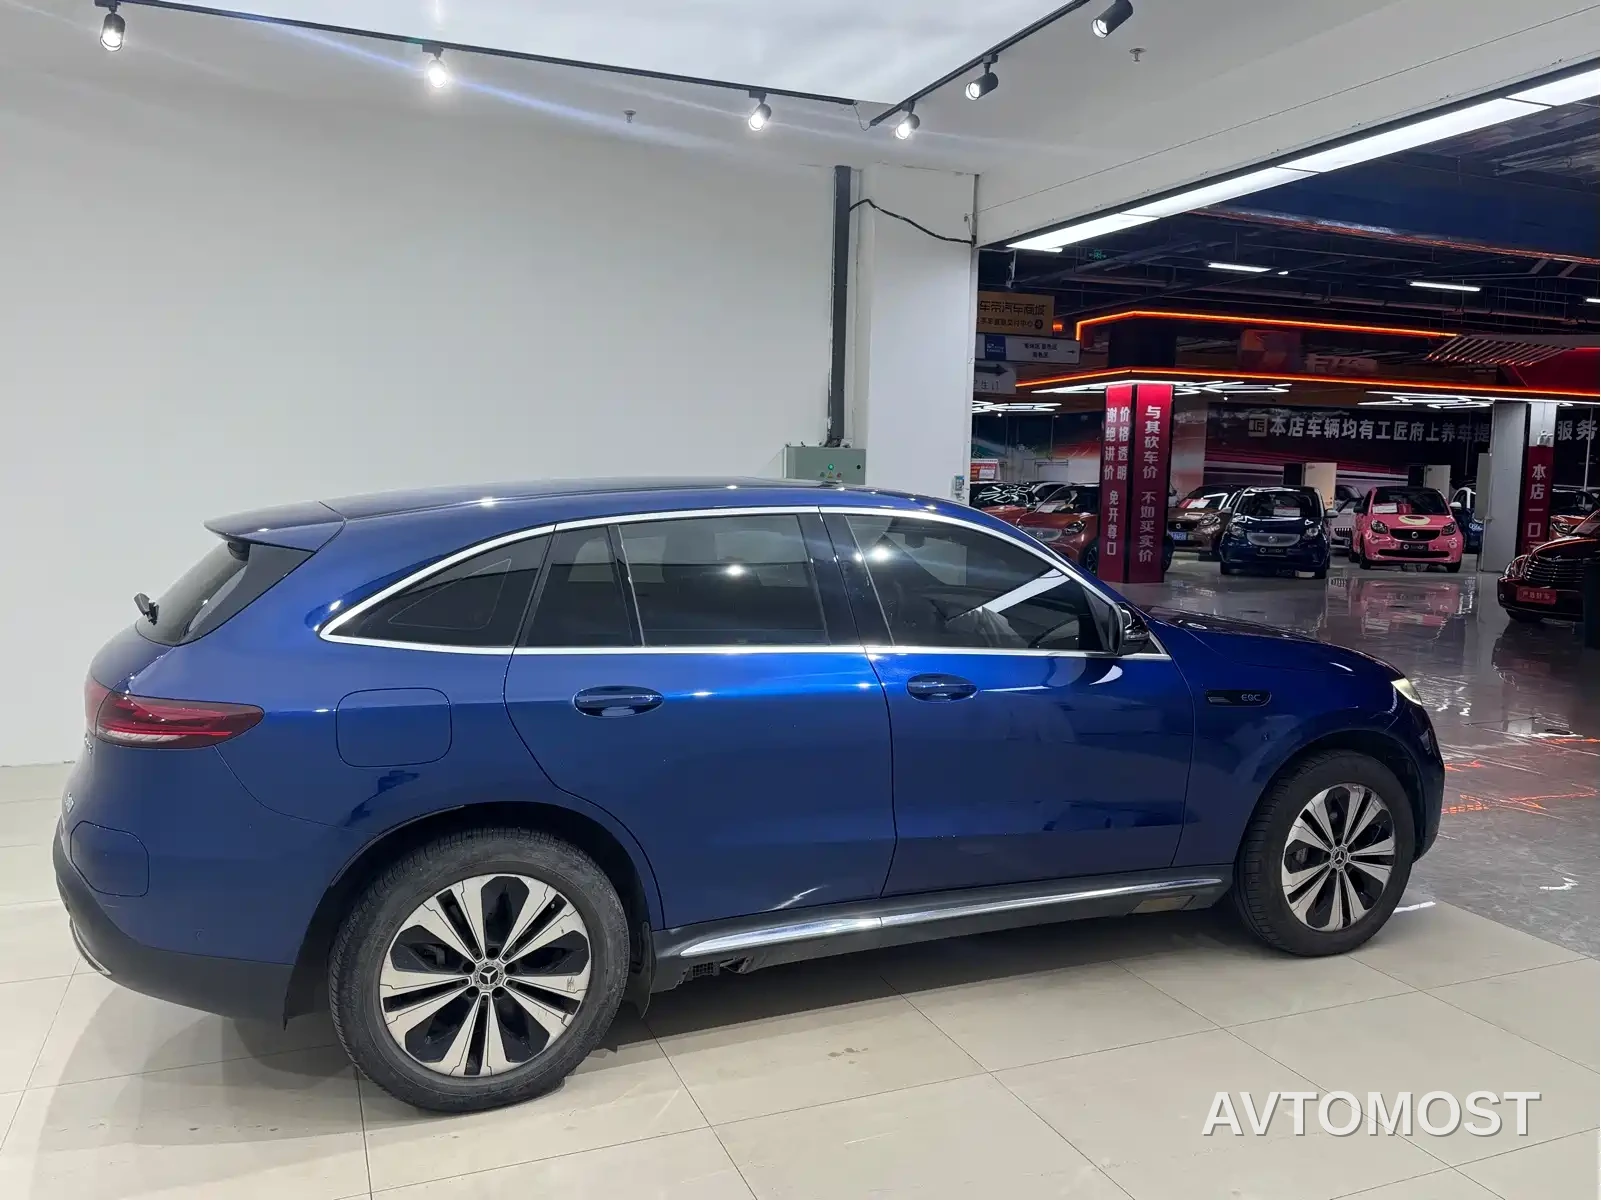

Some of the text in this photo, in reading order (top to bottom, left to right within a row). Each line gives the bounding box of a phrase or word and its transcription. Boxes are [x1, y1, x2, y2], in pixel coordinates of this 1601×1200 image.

[1104, 407, 1117, 480] 谢绝讲价
[1117, 406, 1130, 480] 价格透明
[1557, 420, 1598, 440] 服务
[1139, 405, 1161, 562] 与其砍车价 不如买实价
[1528, 464, 1547, 550] 本店一口
[1107, 490, 1118, 556] 免开尊口
[1240, 693, 1262, 702] EQC
